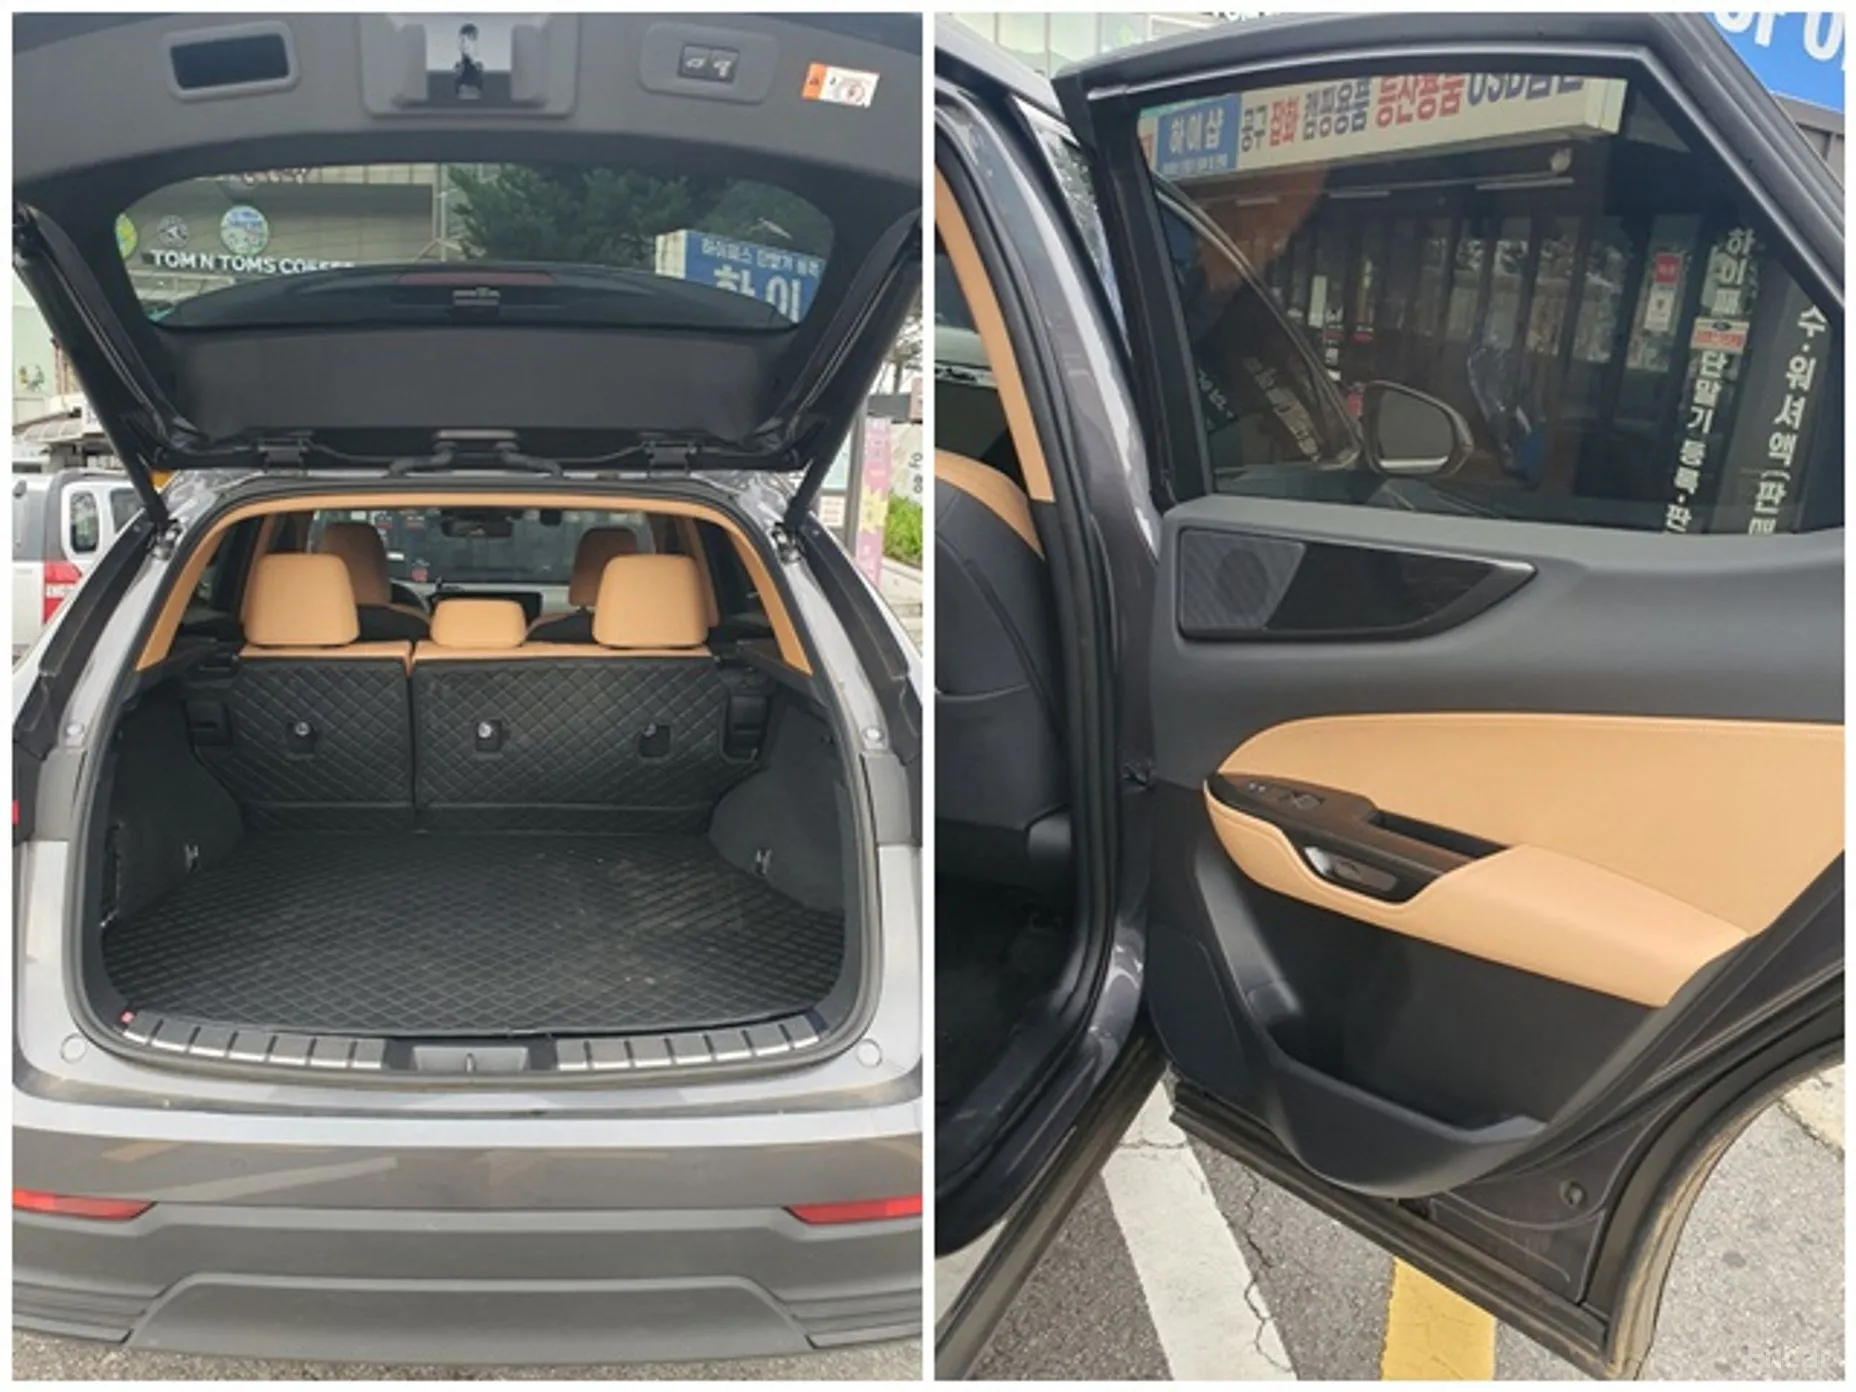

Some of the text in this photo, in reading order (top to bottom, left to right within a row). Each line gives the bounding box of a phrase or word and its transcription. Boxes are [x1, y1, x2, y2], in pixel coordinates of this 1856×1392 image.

[1241, 104, 1268, 151] 공구
[1270, 96, 1299, 146] 잡화
[1303, 78, 1372, 140] 캠핑용품
[151, 250, 196, 268] TOM
[200, 252, 215, 269] N
[219, 254, 277, 273] TOMS
[1687, 351, 1728, 435] 단말기
